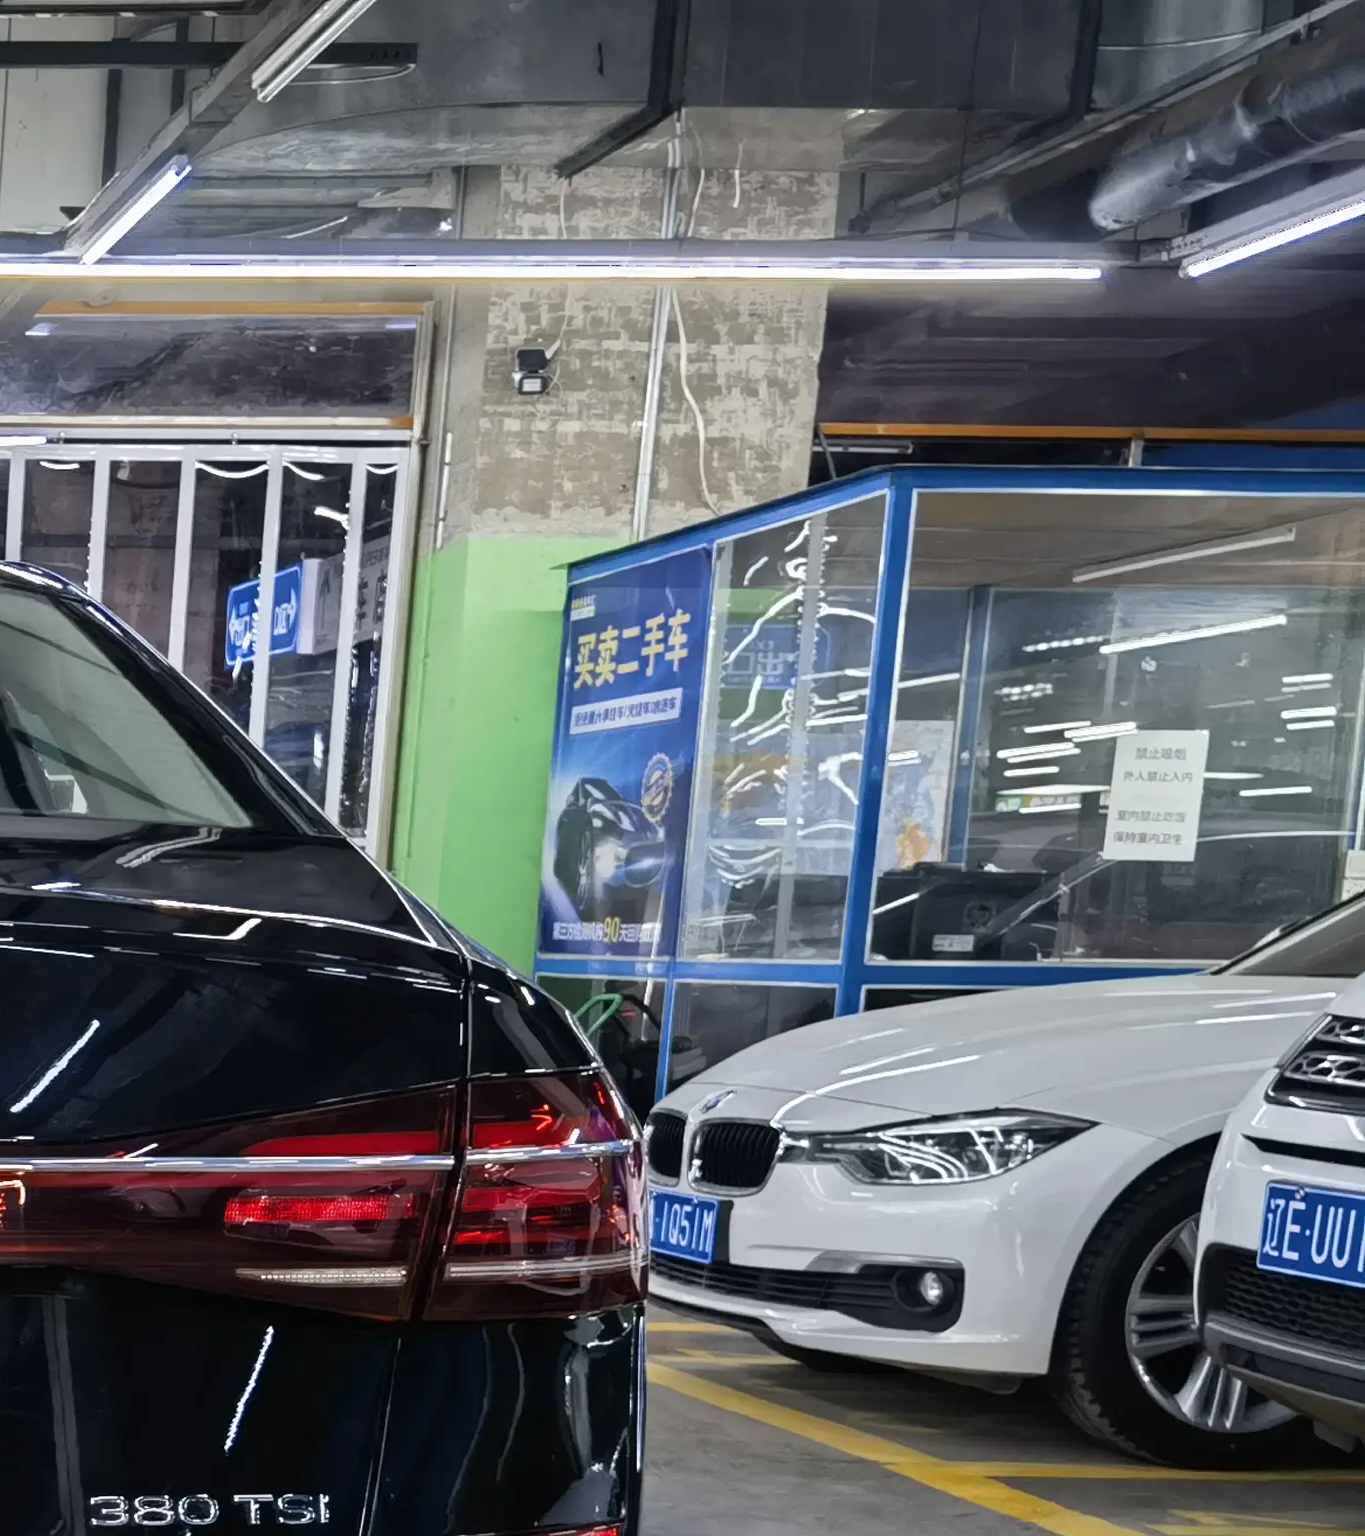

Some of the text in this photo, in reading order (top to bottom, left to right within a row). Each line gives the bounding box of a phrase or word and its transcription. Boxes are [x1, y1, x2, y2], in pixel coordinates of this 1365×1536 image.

[573, 608, 691, 689] 买卖二手车
[89, 1493, 330, 1527] 380 TSI
